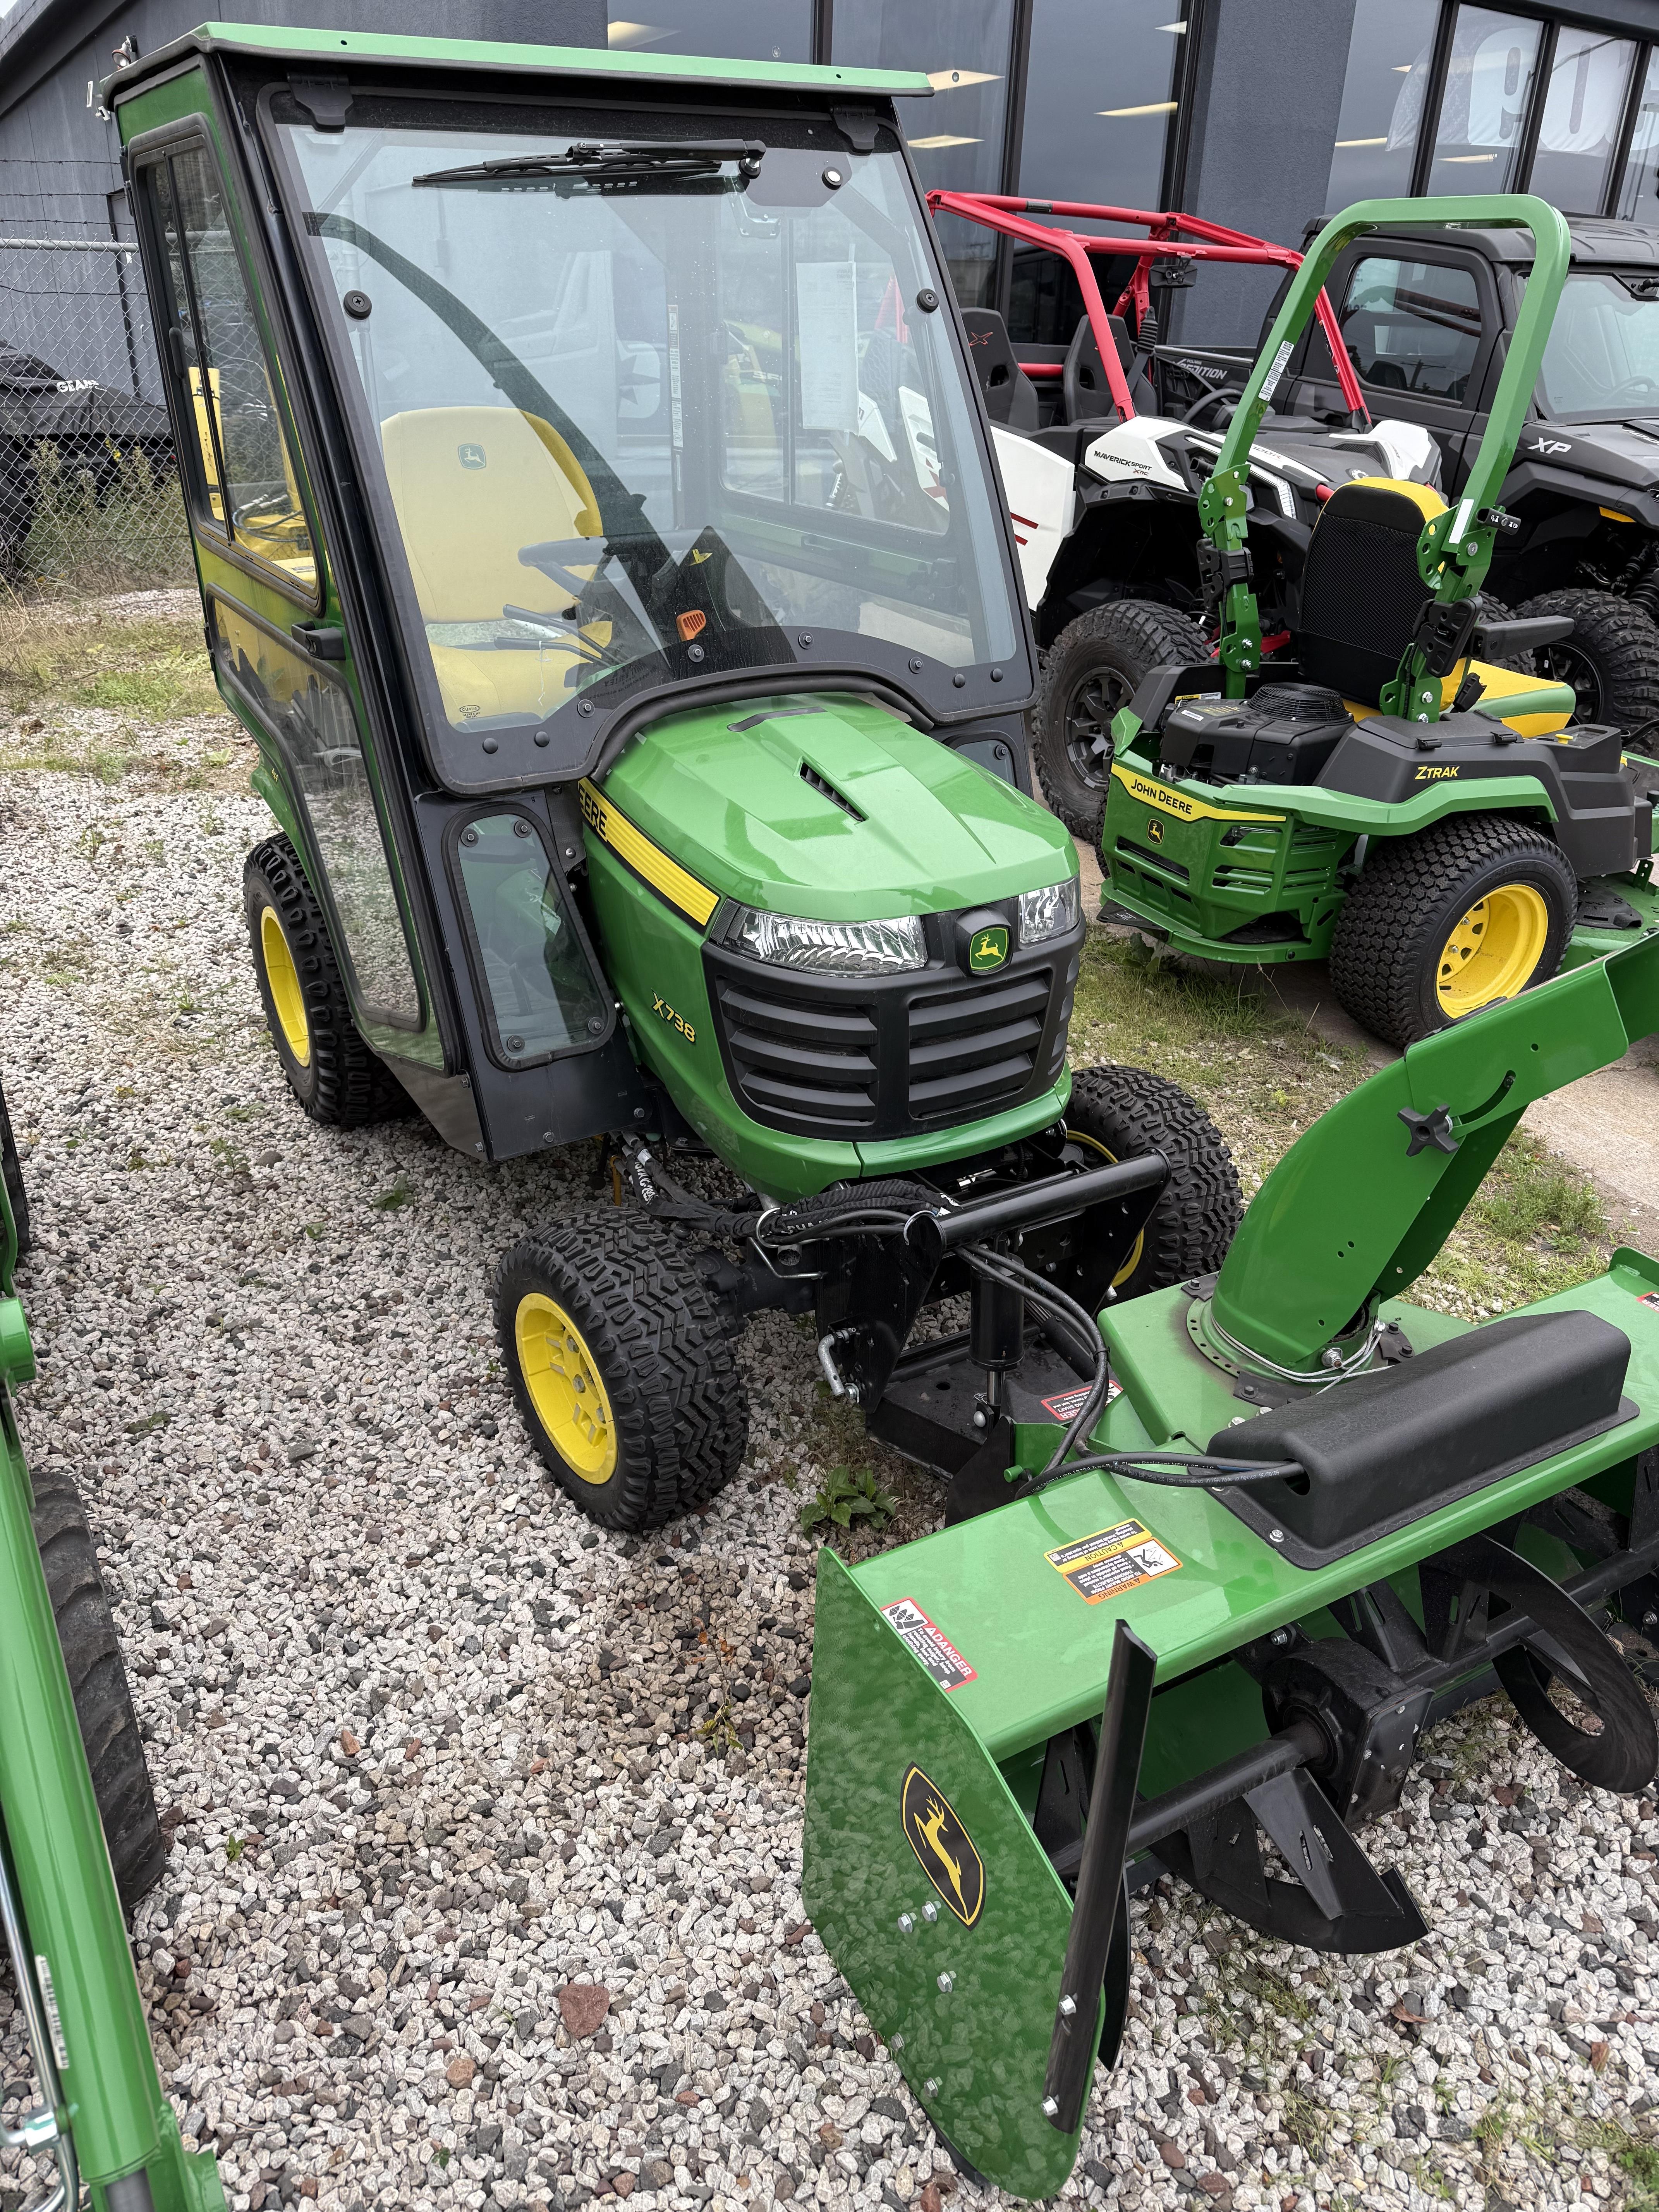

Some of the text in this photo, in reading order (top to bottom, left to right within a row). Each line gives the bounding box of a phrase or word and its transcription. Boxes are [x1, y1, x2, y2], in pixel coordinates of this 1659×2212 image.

[1527, 437, 1572, 454] XP
[1094, 450, 1152, 471] MAVERICK SPORT
[1131, 779, 1193, 815] JOHN DEERE
[652, 990, 696, 1042] X738
[1084, 1545, 1118, 1561] CAUTION
[1092, 1570, 1133, 1589] THROWN OBJECTS
[1105, 1579, 1121, 1589] INJURY
[1098, 1582, 1135, 1599] WARNING
[902, 1635, 919, 1653] clothing
[912, 1630, 928, 1648] rotating
[939, 1662, 950, 1674] keep
[922, 1635, 936, 1647] avoid
[933, 1647, 946, 1660] injury
[945, 1660, 956, 1672] from
[920, 1647, 929, 1657] feet
[927, 1657, 938, 1666] and
[931, 1633, 972, 1677] DANGER
